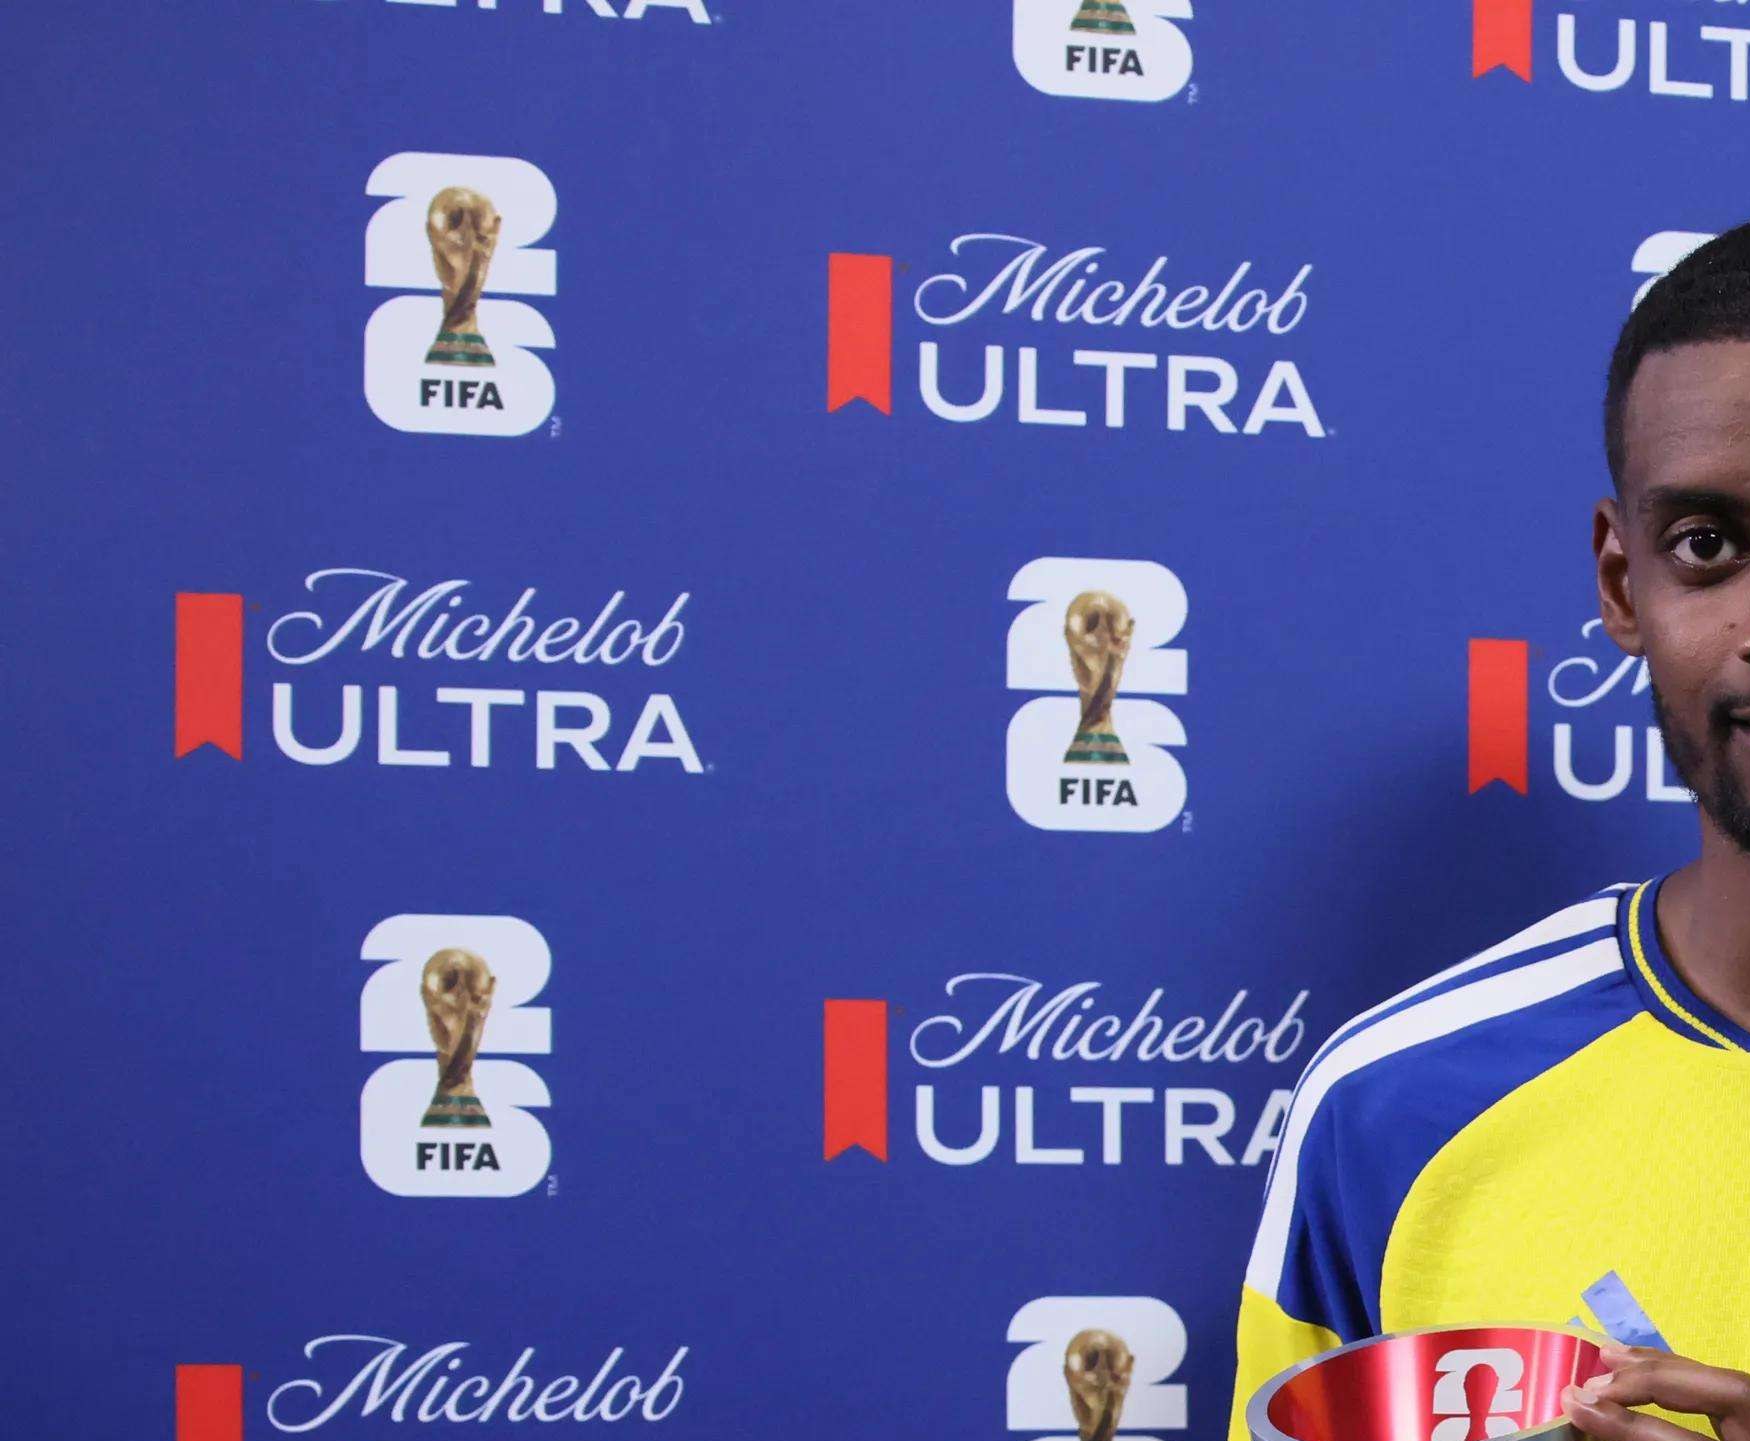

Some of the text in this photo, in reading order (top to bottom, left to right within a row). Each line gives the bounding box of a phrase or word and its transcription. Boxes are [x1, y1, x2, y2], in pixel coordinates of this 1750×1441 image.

[1067, 46, 1143, 76] FIFA
[914, 234, 1312, 334] Michelob
[421, 379, 503, 409] FIFA
[920, 342, 1325, 437] ULTRA
[267, 568, 689, 666] Michelob
[273, 683, 704, 773] ULTRA
[1061, 779, 1137, 806] FIFA
[910, 973, 1308, 1067] Michelob
[417, 1143, 499, 1170] FIFA
[268, 1335, 688, 1432] Michelob
